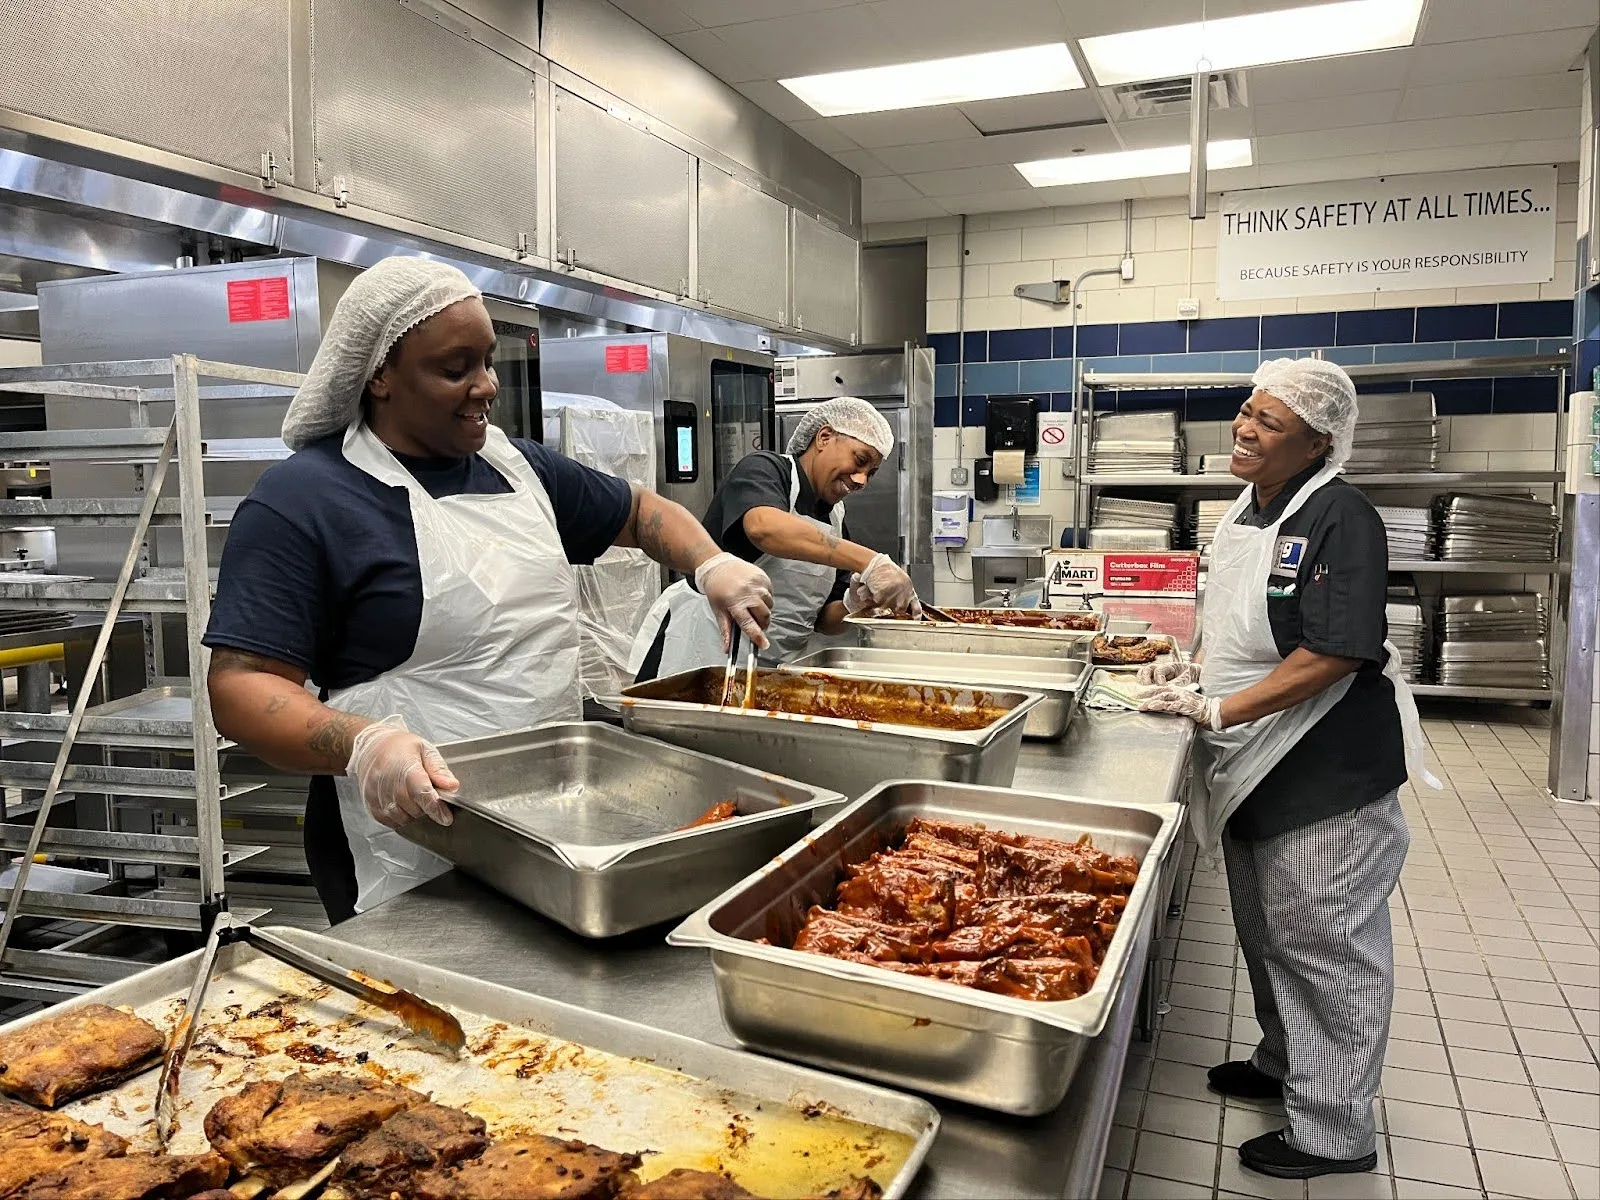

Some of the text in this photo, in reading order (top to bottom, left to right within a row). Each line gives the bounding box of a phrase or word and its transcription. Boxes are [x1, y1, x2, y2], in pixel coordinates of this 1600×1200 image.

[1224, 188, 1550, 235] THINK SAFETY AT ALL TIMES...
[1240, 250, 1529, 280] BECAUSE SAFETY IS YOUR RESPONSIBILITY
[1061, 569, 1095, 579] MART
[1109, 561, 1148, 569] Cutterbox
